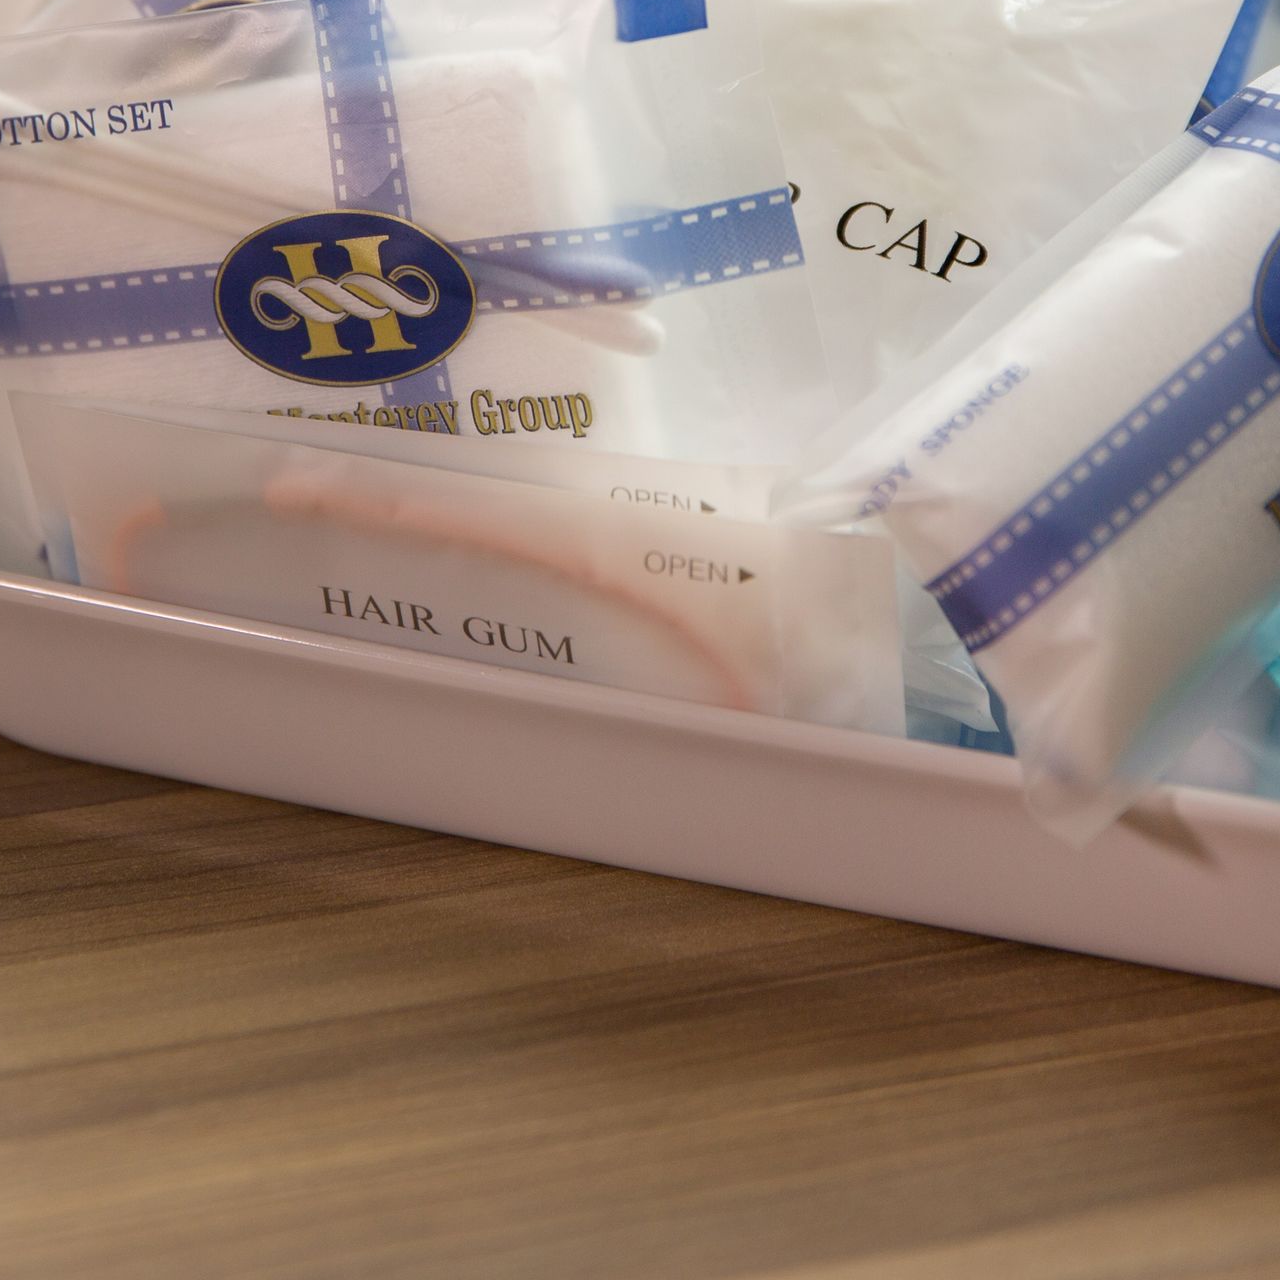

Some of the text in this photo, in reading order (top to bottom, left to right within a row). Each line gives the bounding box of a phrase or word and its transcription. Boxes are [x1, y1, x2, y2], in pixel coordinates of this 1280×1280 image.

[107, 99, 175, 136] SET
[835, 200, 989, 284] CAP
[469, 388, 594, 439] Group
[859, 362, 1030, 517] ODY SPONGE
[644, 549, 728, 585] OPEN
[318, 585, 576, 665] HAIR GUM
